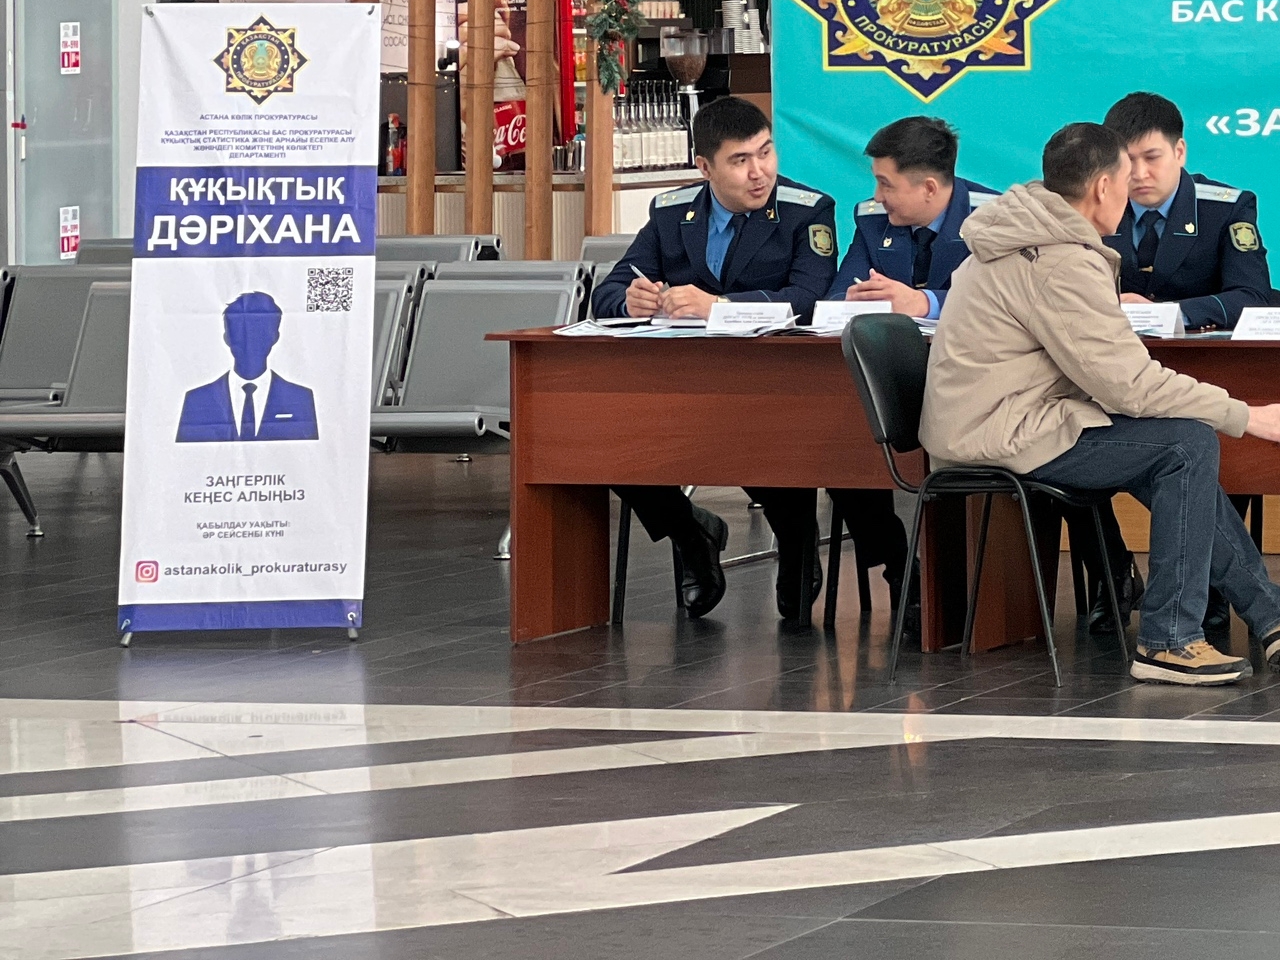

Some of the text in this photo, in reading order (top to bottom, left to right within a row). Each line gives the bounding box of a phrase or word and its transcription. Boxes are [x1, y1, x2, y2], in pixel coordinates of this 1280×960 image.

[855, 14, 997, 54] ПРОКУРАТУРАСЫ
[169, 177, 345, 205] ҚҰҚЫҚТЫҚ
[147, 213, 361, 251] ДӘРІХАНА
[206, 474, 286, 488] ЗАҢГЕРЛІК
[184, 489, 306, 504] КЕҢЕС АЛЫҢЫЗ
[196, 521, 247, 530] ҚАБЫЛДАУ
[202, 530, 215, 539] ӘР
[217, 529, 263, 539] СЕЙСЕНБІ
[164, 561, 347, 577] astanakolik_prokuraturasy
